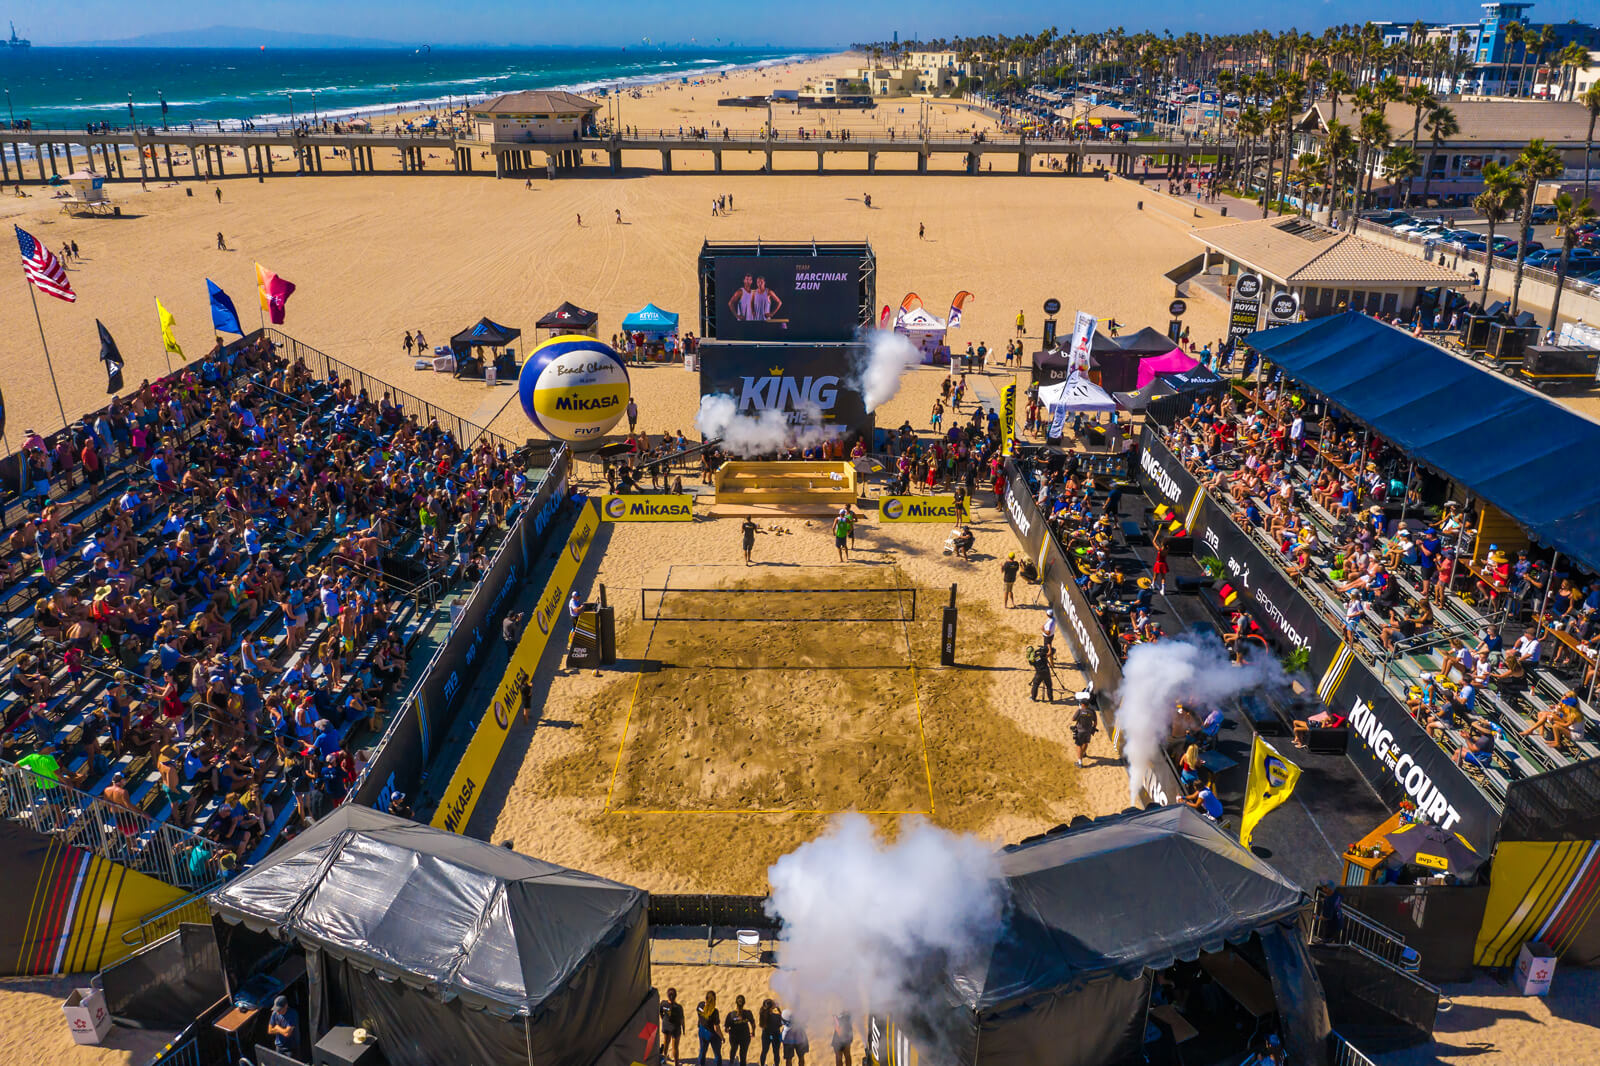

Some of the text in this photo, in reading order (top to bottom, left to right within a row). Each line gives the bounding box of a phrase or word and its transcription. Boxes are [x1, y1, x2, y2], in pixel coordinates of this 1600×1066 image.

[795, 272, 848, 281] MARCINIAK
[794, 282, 821, 291] ZAUN
[1234, 303, 1257, 312] ROYAL
[557, 361, 615, 376] Beach Champ
[555, 393, 620, 411] MIKASA
[738, 375, 840, 410] KING
[1141, 447, 1182, 503] KING COURT
[629, 499, 691, 515] MIKASA
[1227, 556, 1241, 577] avp
[1078, 619, 1100, 674] COURT
[1348, 694, 1462, 830] KING OF THE COURT
[443, 776, 477, 833] MIKASA
